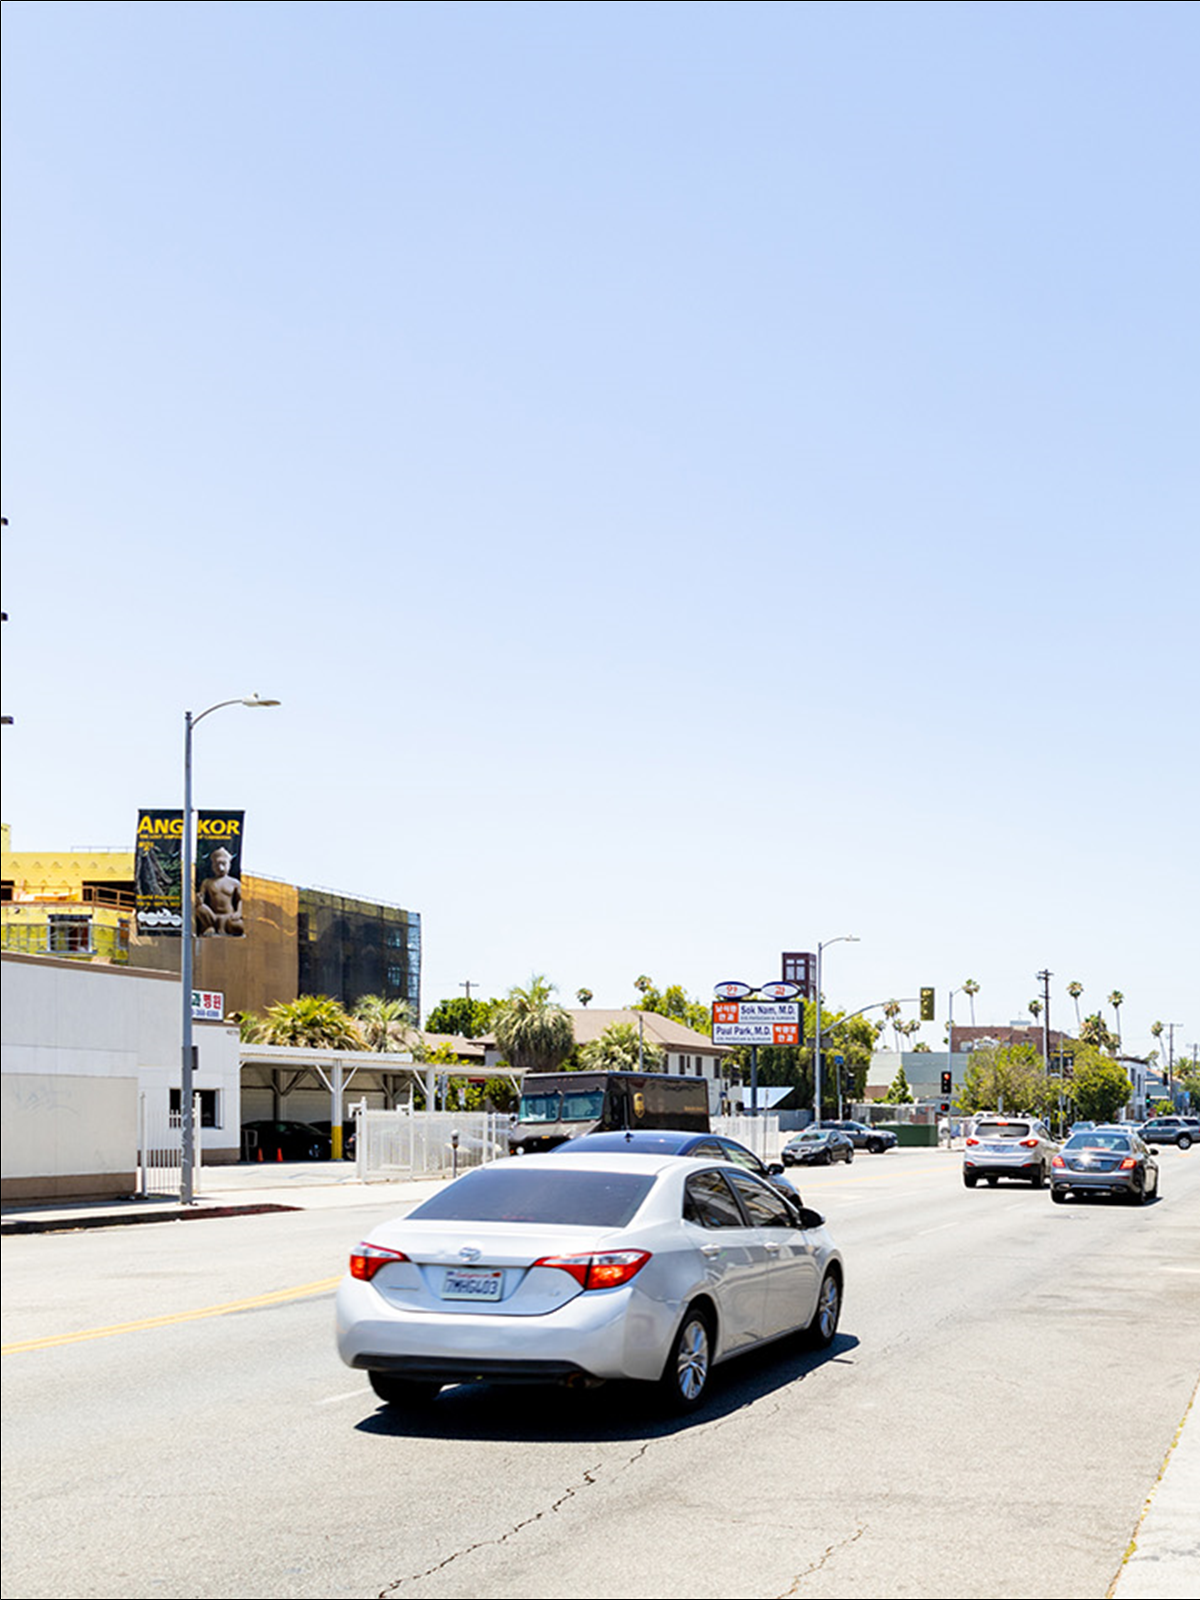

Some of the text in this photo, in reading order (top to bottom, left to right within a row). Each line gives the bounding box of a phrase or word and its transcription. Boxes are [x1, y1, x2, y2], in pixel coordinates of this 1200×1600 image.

[741, 1005, 755, 1014] Sok
[779, 1005, 796, 1014] M.D.
[716, 1026, 733, 1035] Paul
[734, 1026, 753, 1035] Park,
[754, 1026, 771, 1035] M.D.
[446, 1280, 498, 1294] 7MHG403
